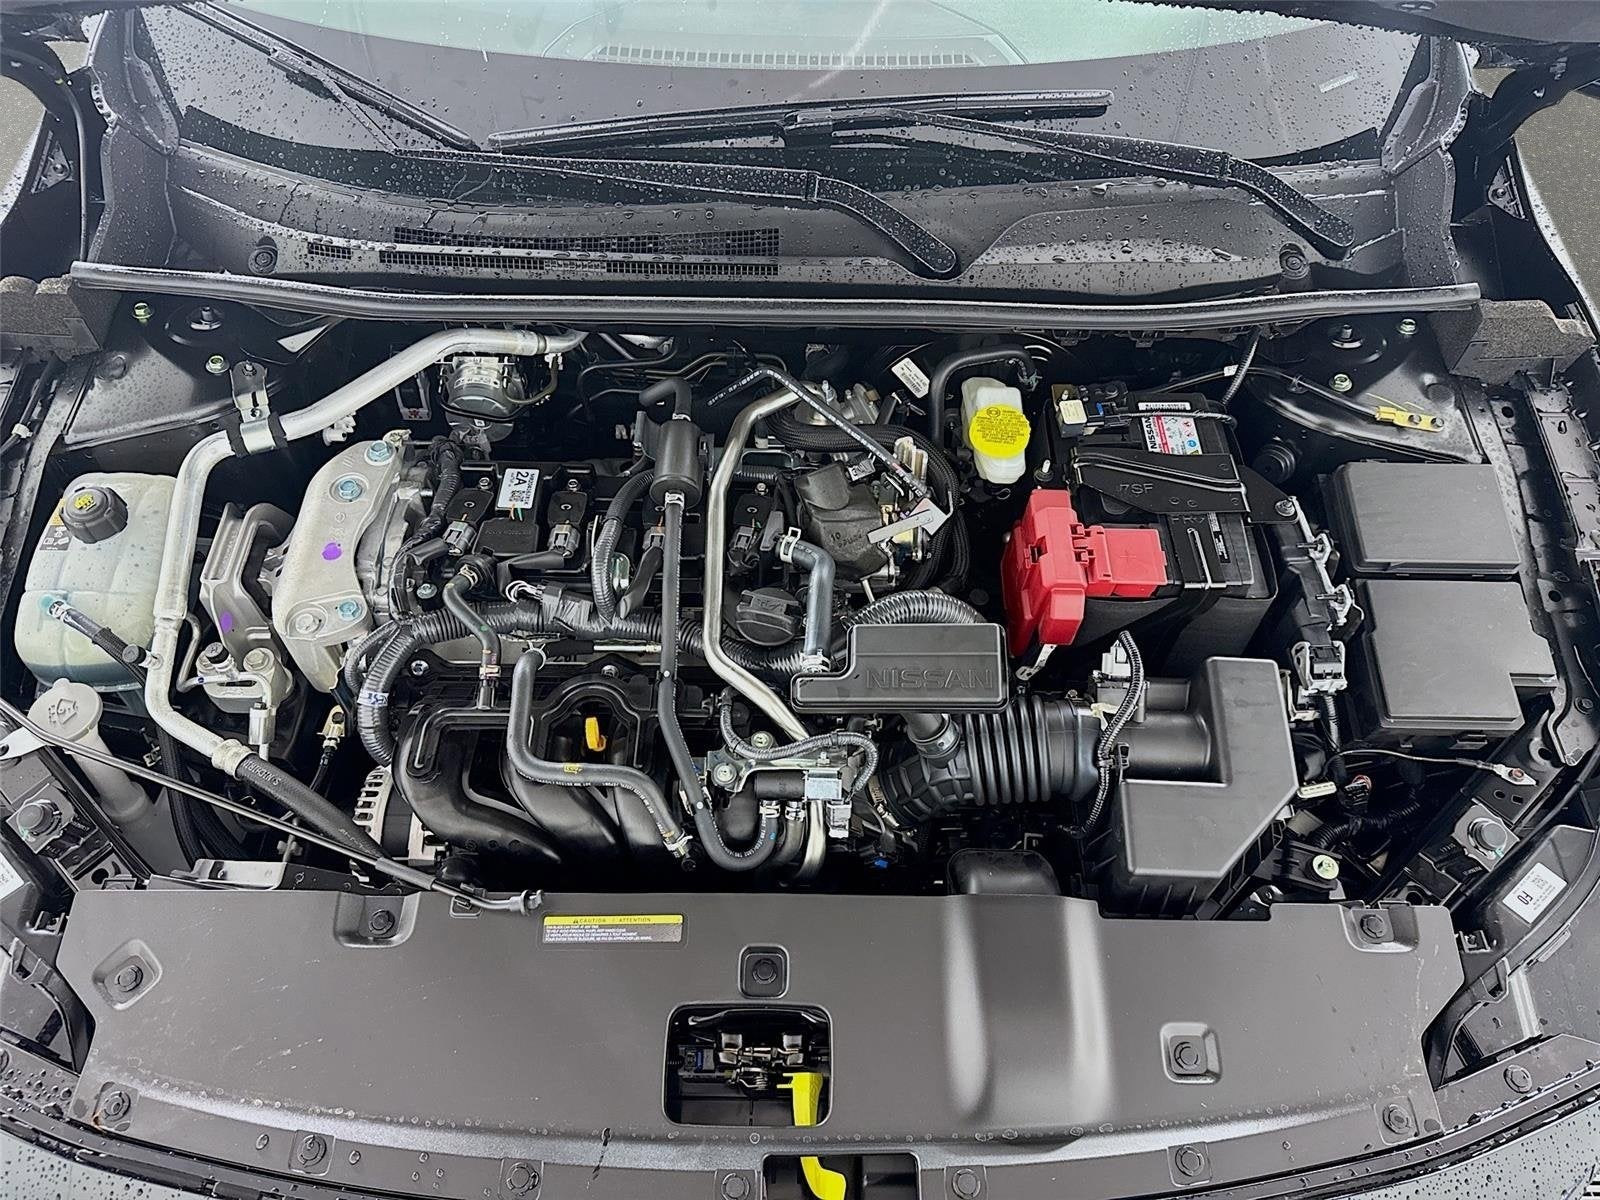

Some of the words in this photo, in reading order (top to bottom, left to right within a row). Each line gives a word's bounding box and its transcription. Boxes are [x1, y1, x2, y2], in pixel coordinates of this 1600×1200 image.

[1144, 416, 1157, 449] NISSAN
[514, 471, 529, 486] 2A
[866, 668, 993, 689] NISSAN
